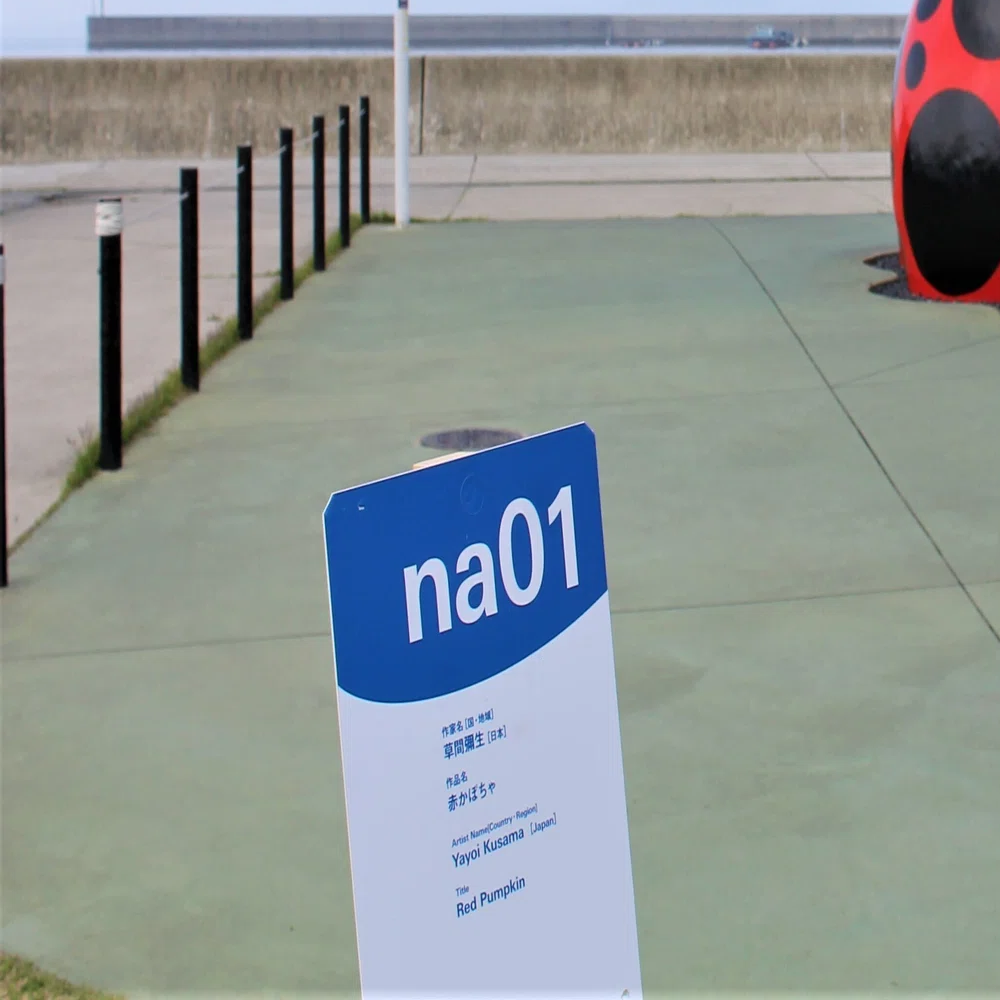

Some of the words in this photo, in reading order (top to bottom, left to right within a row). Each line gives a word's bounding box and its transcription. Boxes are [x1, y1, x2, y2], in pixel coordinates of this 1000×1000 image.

[403, 485, 579, 644] na01
[445, 771, 468, 790] 作品名
[447, 782, 496, 812] 赤かぼちゃ
[451, 843, 480, 868] Yayoi
[482, 828, 525, 855] Kusama
[530, 812, 557, 835] [Japan]
[451, 834, 470, 848] Artist
[455, 885, 469, 897] Title
[456, 895, 477, 918] Red
[479, 876, 526, 907] Pumpkin
